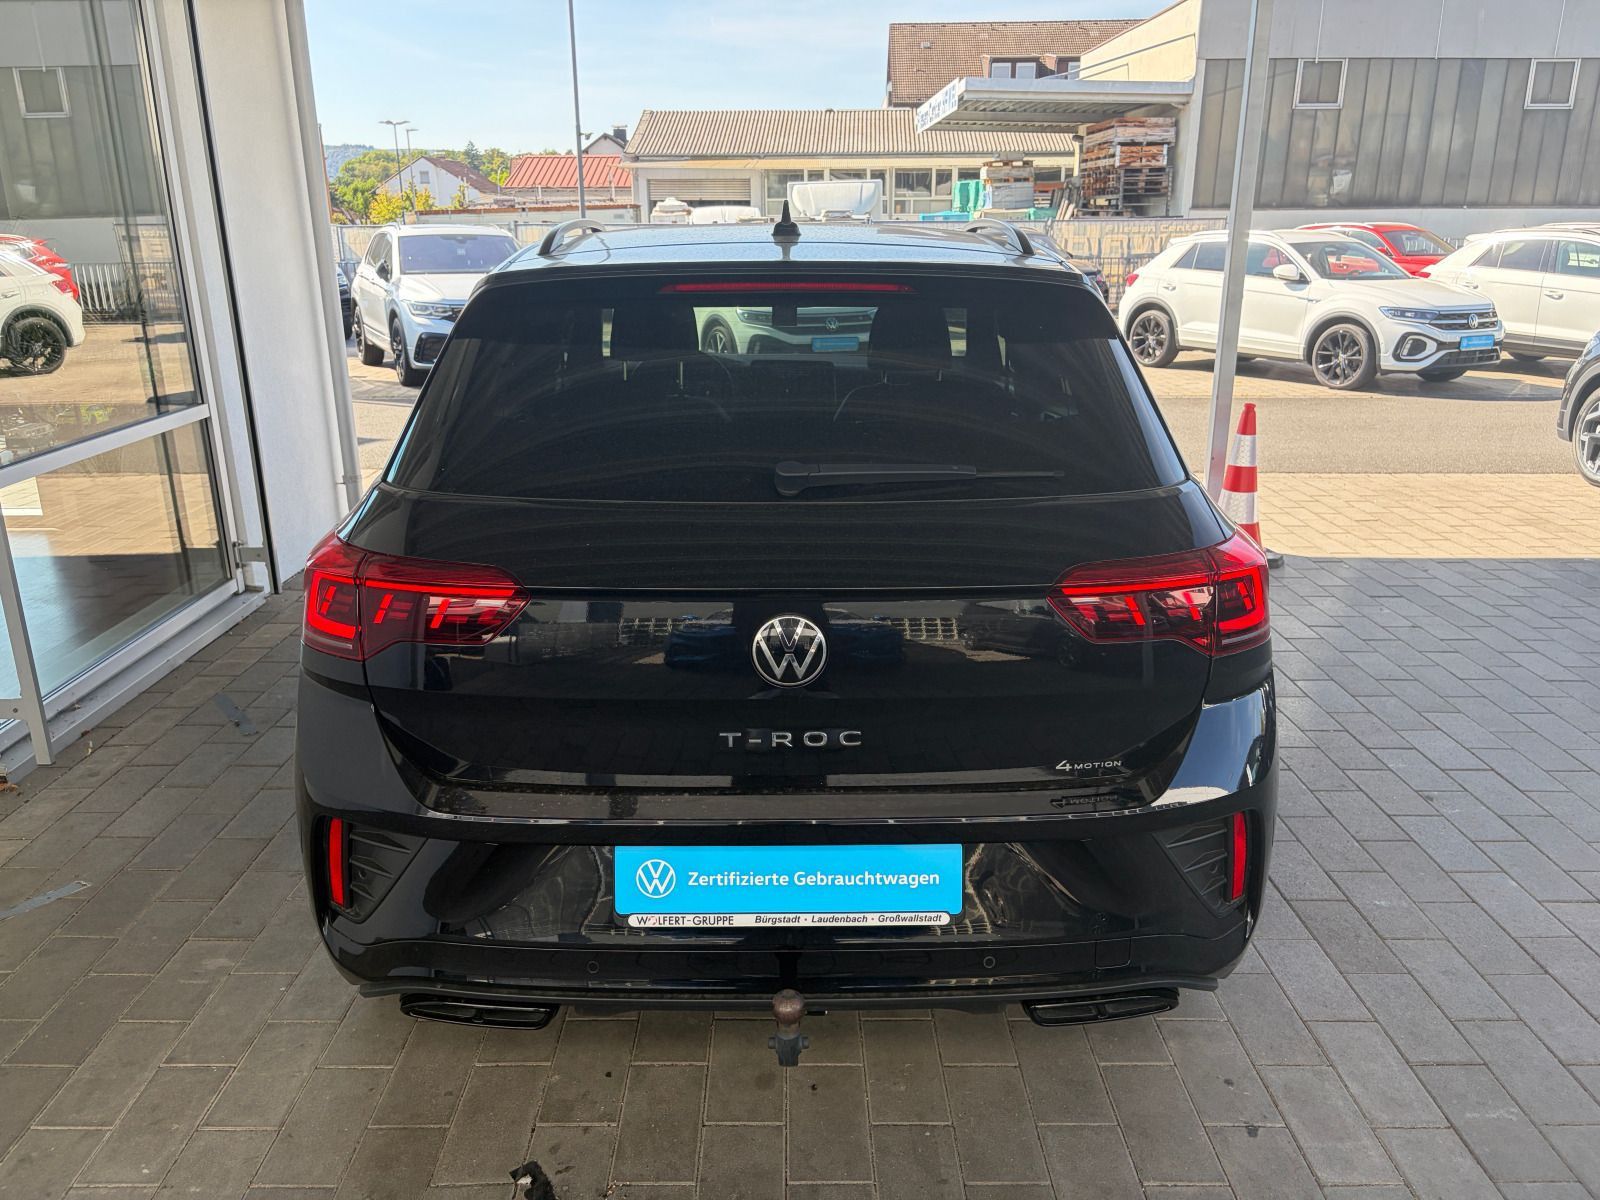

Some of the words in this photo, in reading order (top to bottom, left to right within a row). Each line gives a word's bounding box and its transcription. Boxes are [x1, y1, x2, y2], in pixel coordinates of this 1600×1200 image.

[752, 616, 827, 688] VW
[719, 730, 862, 748] T-ROC
[636, 859, 676, 898] VW
[688, 871, 789, 887] Zertifizierte
[793, 870, 940, 888] Gebrauchtwagen
[636, 915, 734, 926] WOLFERT-GRUPPE
[754, 914, 801, 925] Bürgstadt
[811, 914, 868, 924] Laudenbach
[877, 913, 942, 924] Großwallstadt
